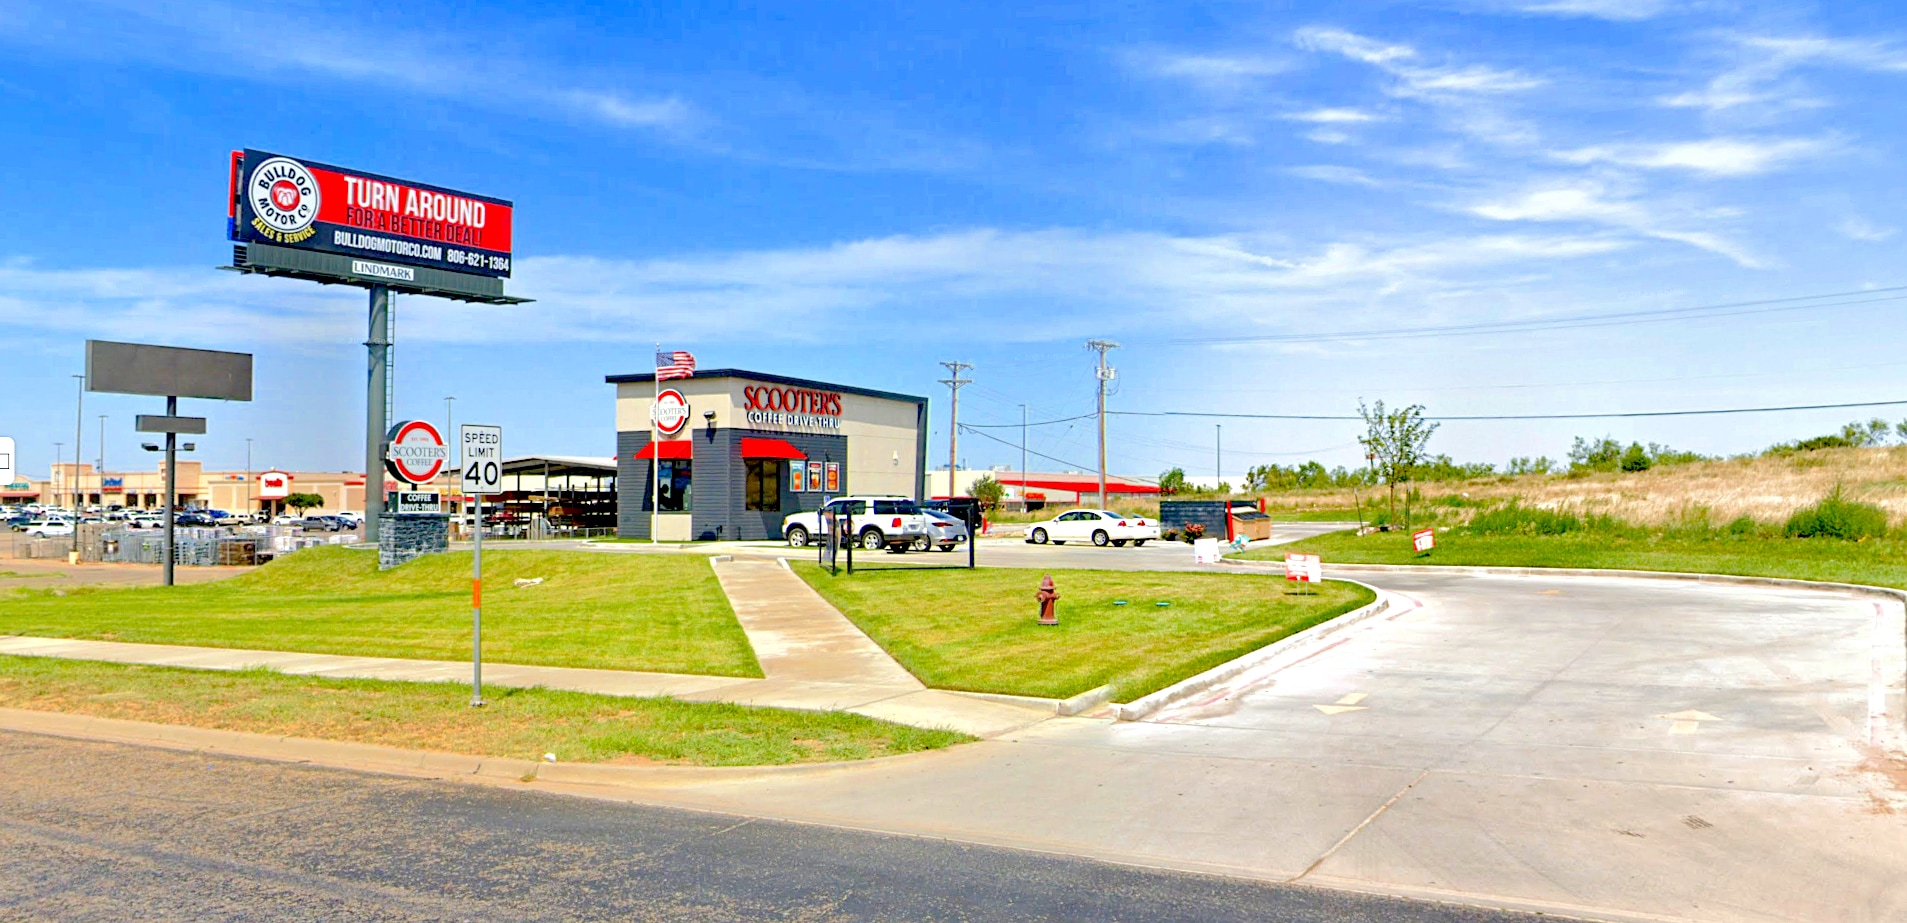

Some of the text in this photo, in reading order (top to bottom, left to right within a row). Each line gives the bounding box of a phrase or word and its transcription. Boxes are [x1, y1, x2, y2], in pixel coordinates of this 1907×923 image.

[259, 165, 312, 197] BULLDOG
[259, 198, 297, 225] MOTOR
[344, 176, 485, 228] TURN AROUND
[251, 217, 317, 244] SALES & SERVICE
[346, 206, 483, 246] FOR A BETTER DEAL!
[334, 230, 510, 272] BULLDOGMOTORCO.COM 806-621-1364
[353, 262, 413, 280] LINDMARK
[744, 386, 842, 416] SCOOTER'S
[747, 411, 784, 426] COFFEE
[465, 432, 499, 444] SPEED
[393, 446, 446, 458] SCOOTER'S
[406, 458, 433, 467] COFFEE
[468, 447, 495, 458] LIMIT
[464, 461, 498, 486] 40
[400, 503, 440, 512] DRIVE-THRU
[406, 494, 432, 502] COFFEE
